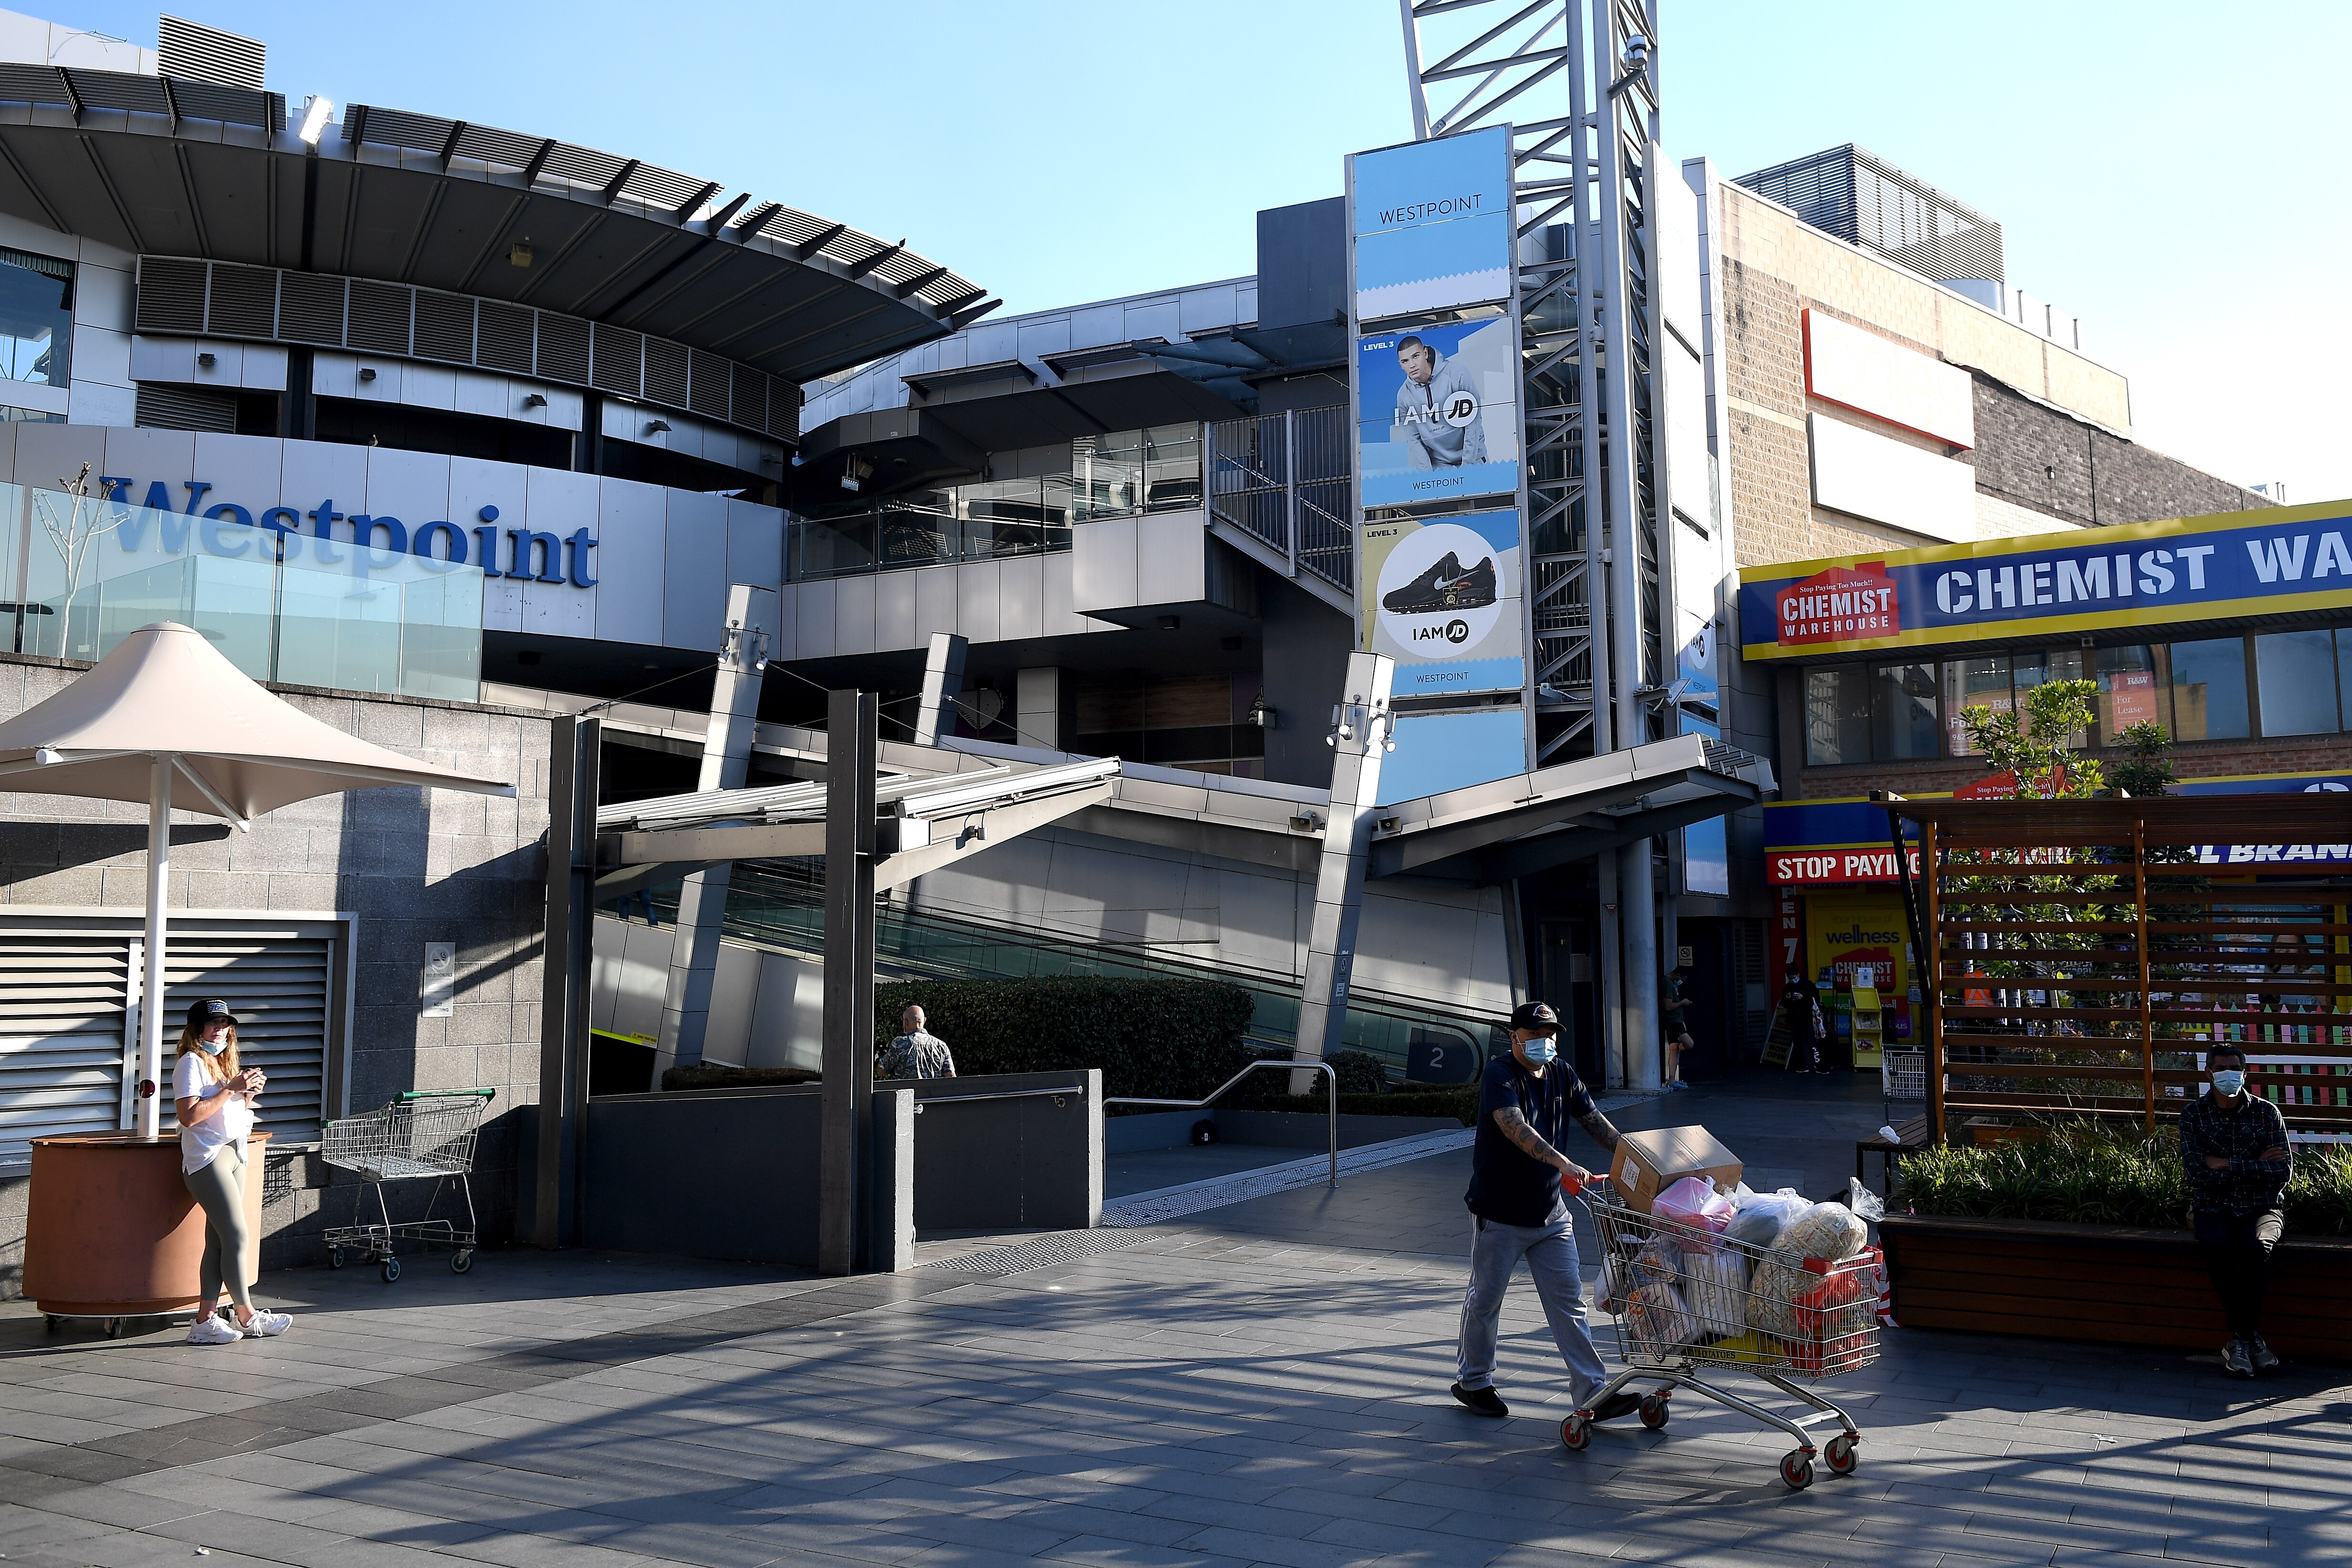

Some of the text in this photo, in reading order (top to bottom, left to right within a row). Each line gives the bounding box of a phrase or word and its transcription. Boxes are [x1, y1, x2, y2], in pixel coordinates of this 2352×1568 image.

[1379, 194, 1482, 225] WESTPOINT
[1363, 342, 1388, 351] LEVEL
[1394, 408, 1399, 427] I
[1403, 403, 1440, 426] AM
[1412, 477, 1464, 490] WESTPOINT
[99, 476, 598, 598] Westpoint
[1367, 530, 1391, 538] LEVEL
[1799, 585, 1814, 594] Stop
[1815, 583, 1836, 592] Paying
[1850, 579, 1873, 587] Much!!
[1936, 545, 2215, 614] CHEMIST
[1783, 588, 1891, 621] CHEMIST
[1413, 628, 1416, 641] I
[1419, 626, 1443, 640] AM
[1784, 615, 1889, 637] WAREHOUSE
[1416, 672, 1468, 683] WESTPOINT
[2127, 676, 2148, 685] R&W
[2228, 845, 2352, 863] BRAN
[1777, 857, 1837, 880] STOP
[1826, 924, 1900, 943] wellness
[1783, 938, 1798, 964] 7
[1836, 962, 1892, 974] CHEMIST
[1430, 1047, 1444, 1068] 2
[1767, 1051, 1787, 1060] OPEN
[1769, 1044, 1788, 1053] NOW
